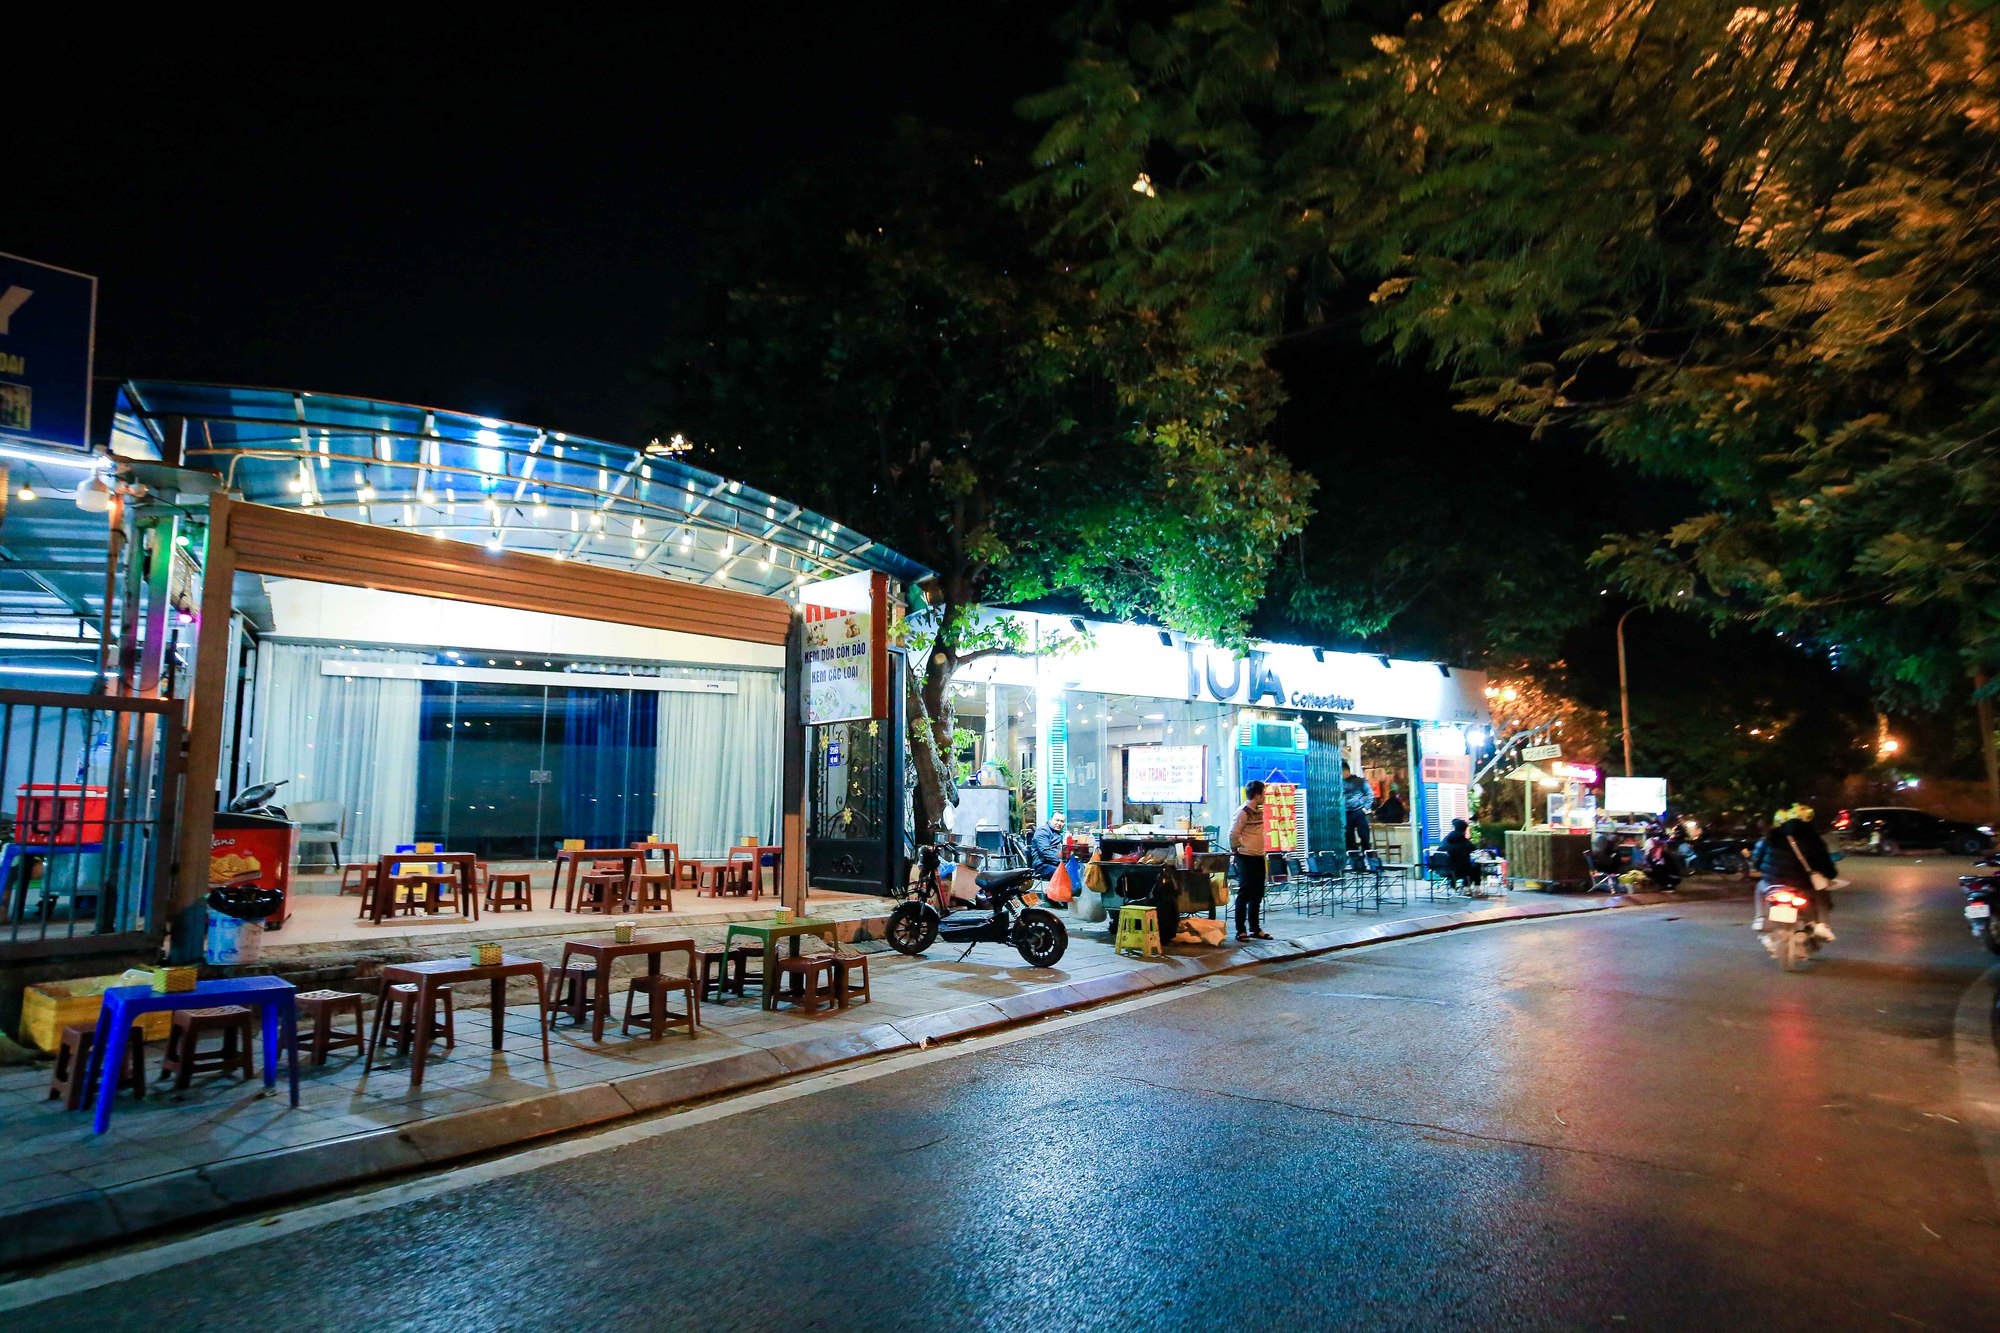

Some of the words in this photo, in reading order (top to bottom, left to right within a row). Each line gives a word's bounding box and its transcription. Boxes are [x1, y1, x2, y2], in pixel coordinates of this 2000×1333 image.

[804, 650, 820, 664] KEM
[811, 669, 827, 684] KEM
[843, 665, 859, 681] LOẠI
